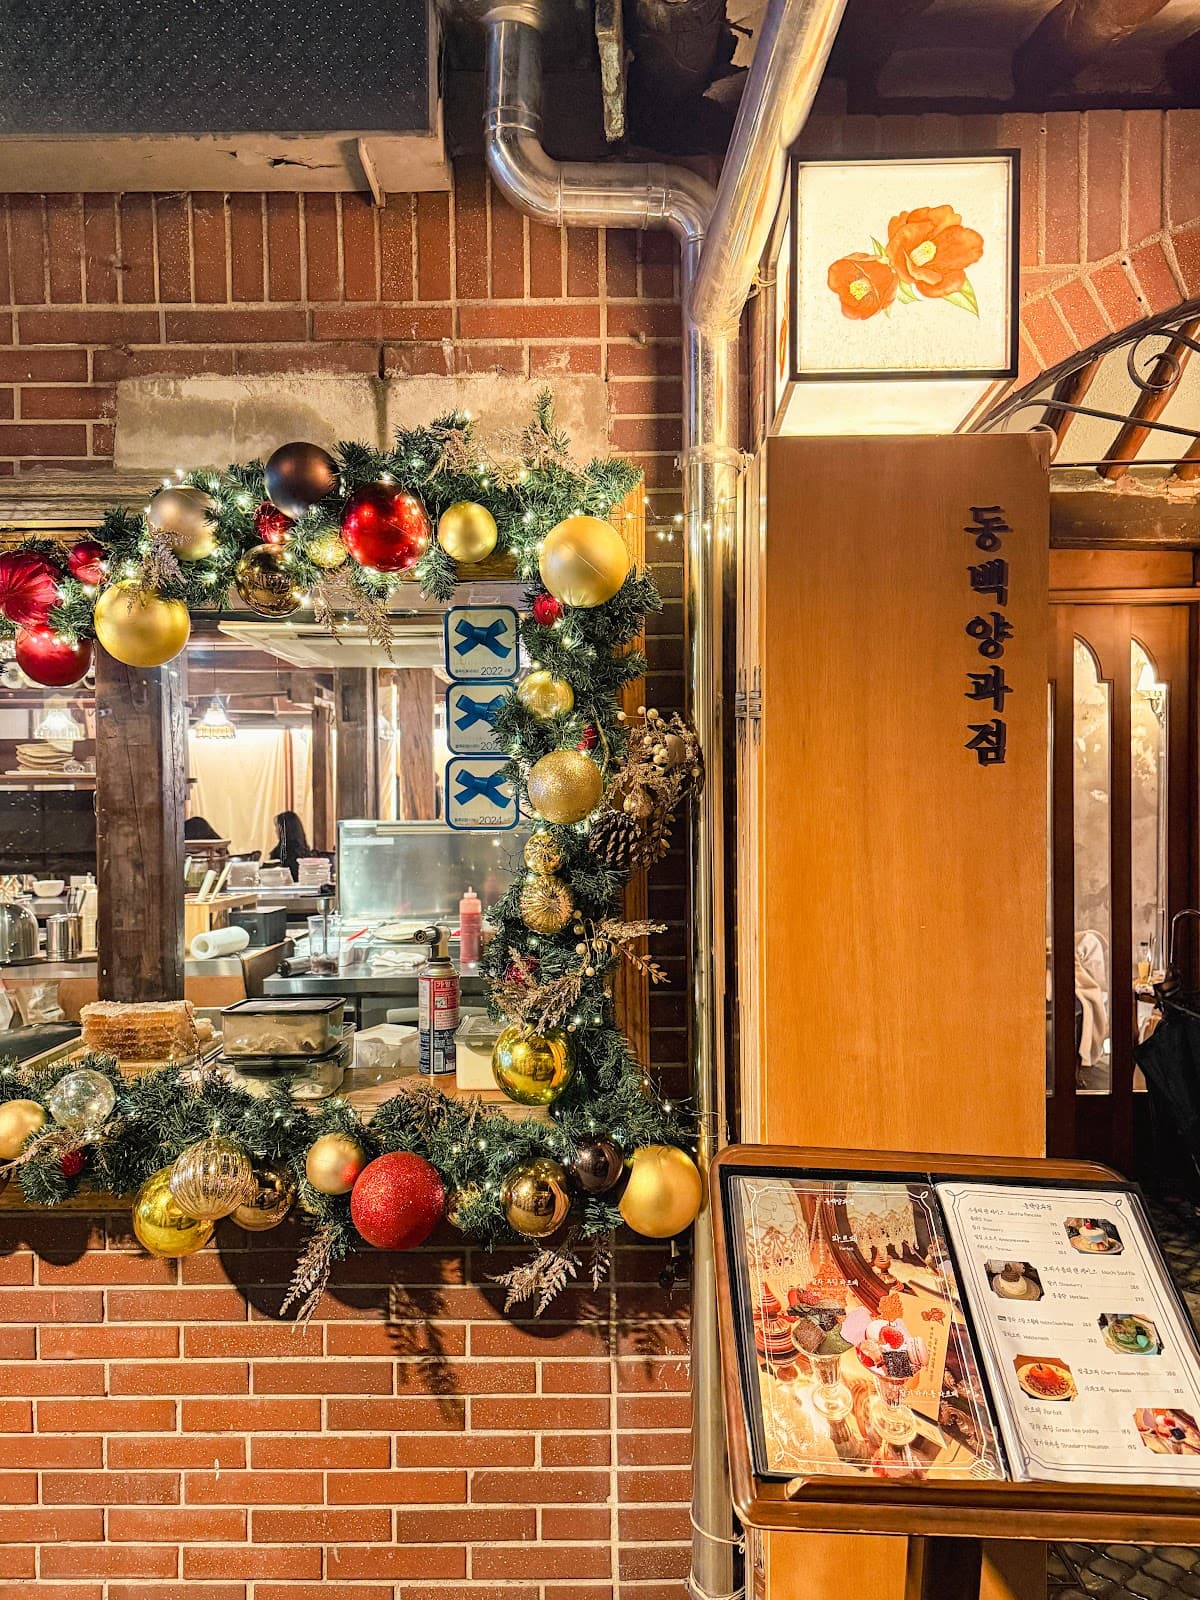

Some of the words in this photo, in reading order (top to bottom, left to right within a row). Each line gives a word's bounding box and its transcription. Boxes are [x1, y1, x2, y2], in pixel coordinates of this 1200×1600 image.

[964, 505, 1013, 767] 동백양과점
[480, 665, 503, 676] 2022
[480, 741, 503, 751] 202
[479, 815, 503, 825] 2024
